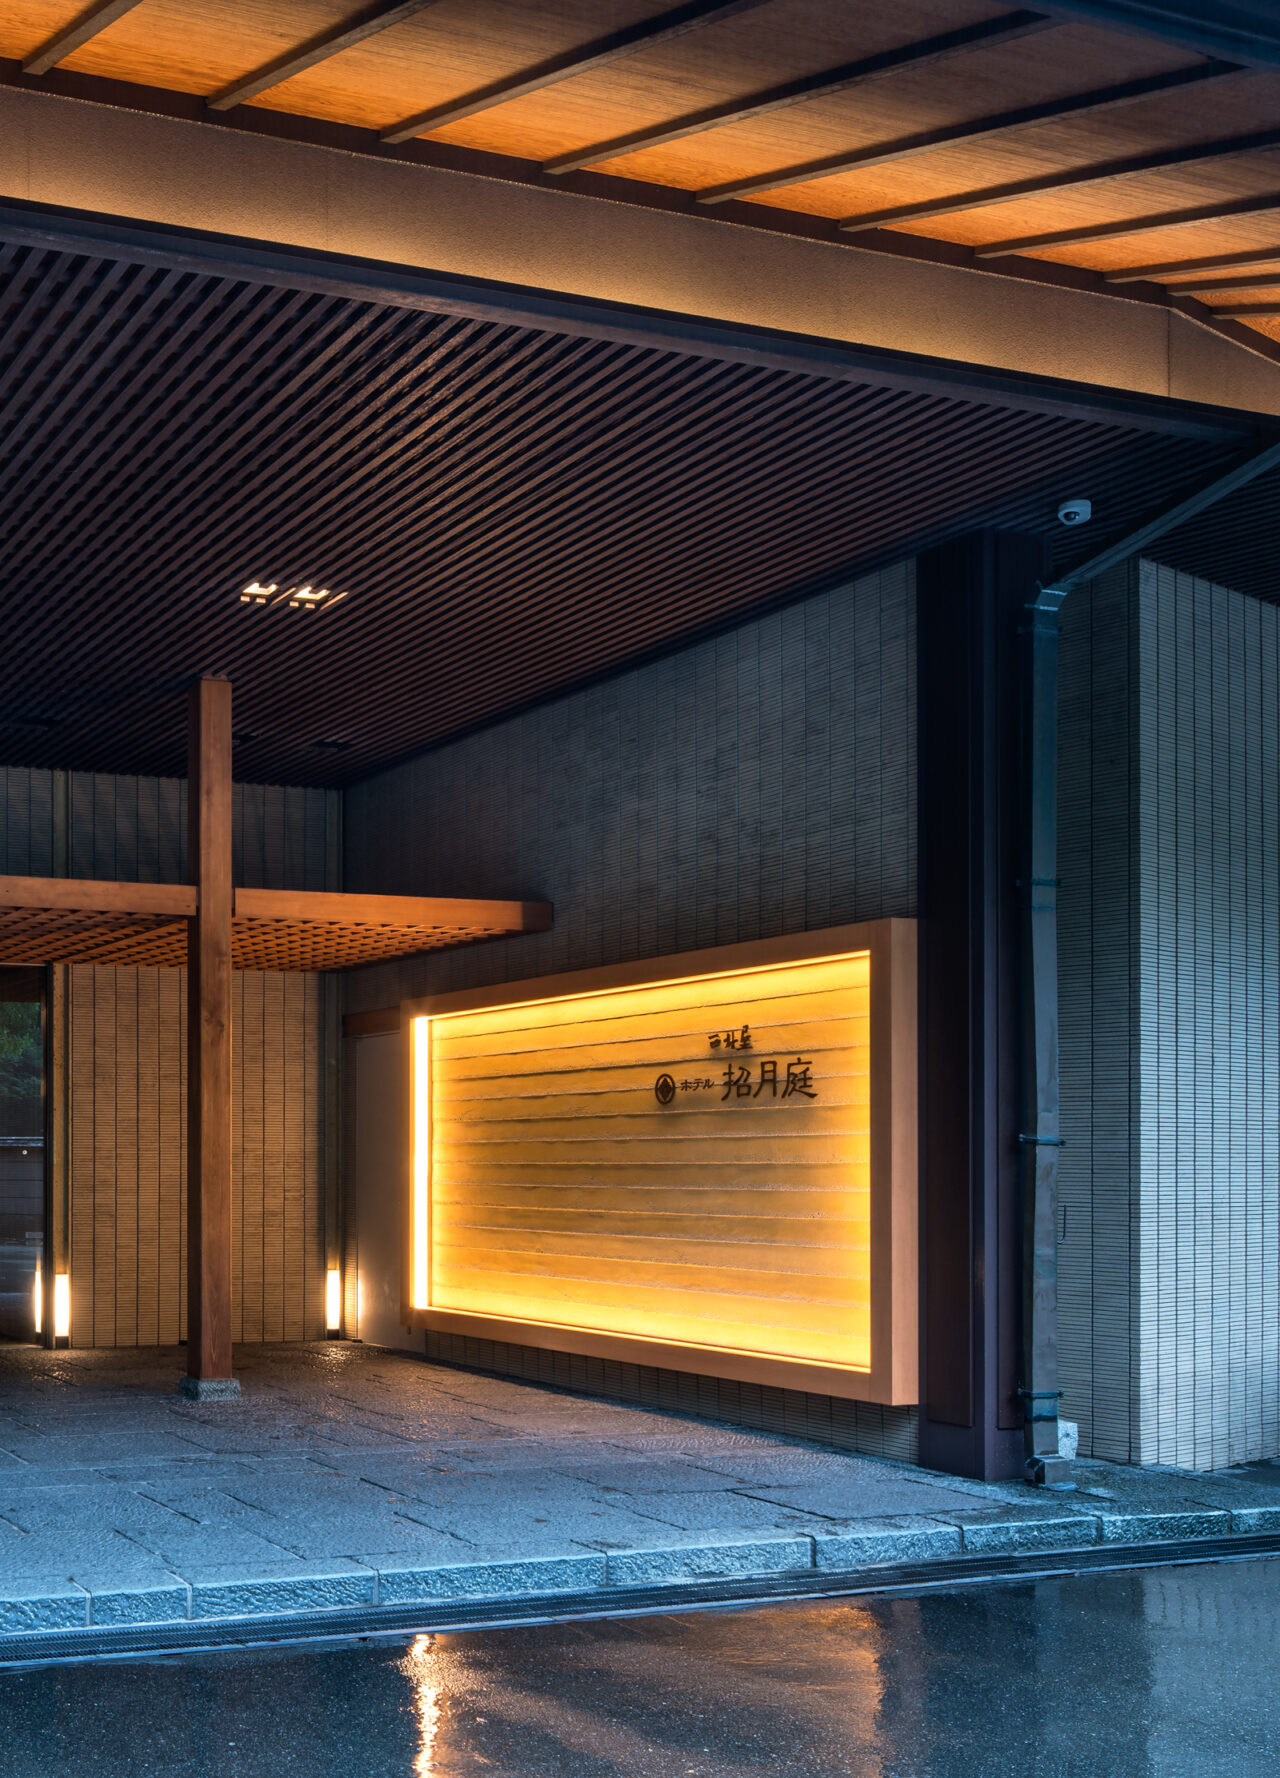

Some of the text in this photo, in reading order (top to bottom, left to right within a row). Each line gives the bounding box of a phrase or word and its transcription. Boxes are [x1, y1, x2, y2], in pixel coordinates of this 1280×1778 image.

[680, 1057, 818, 1101] ホテル 招月庭
